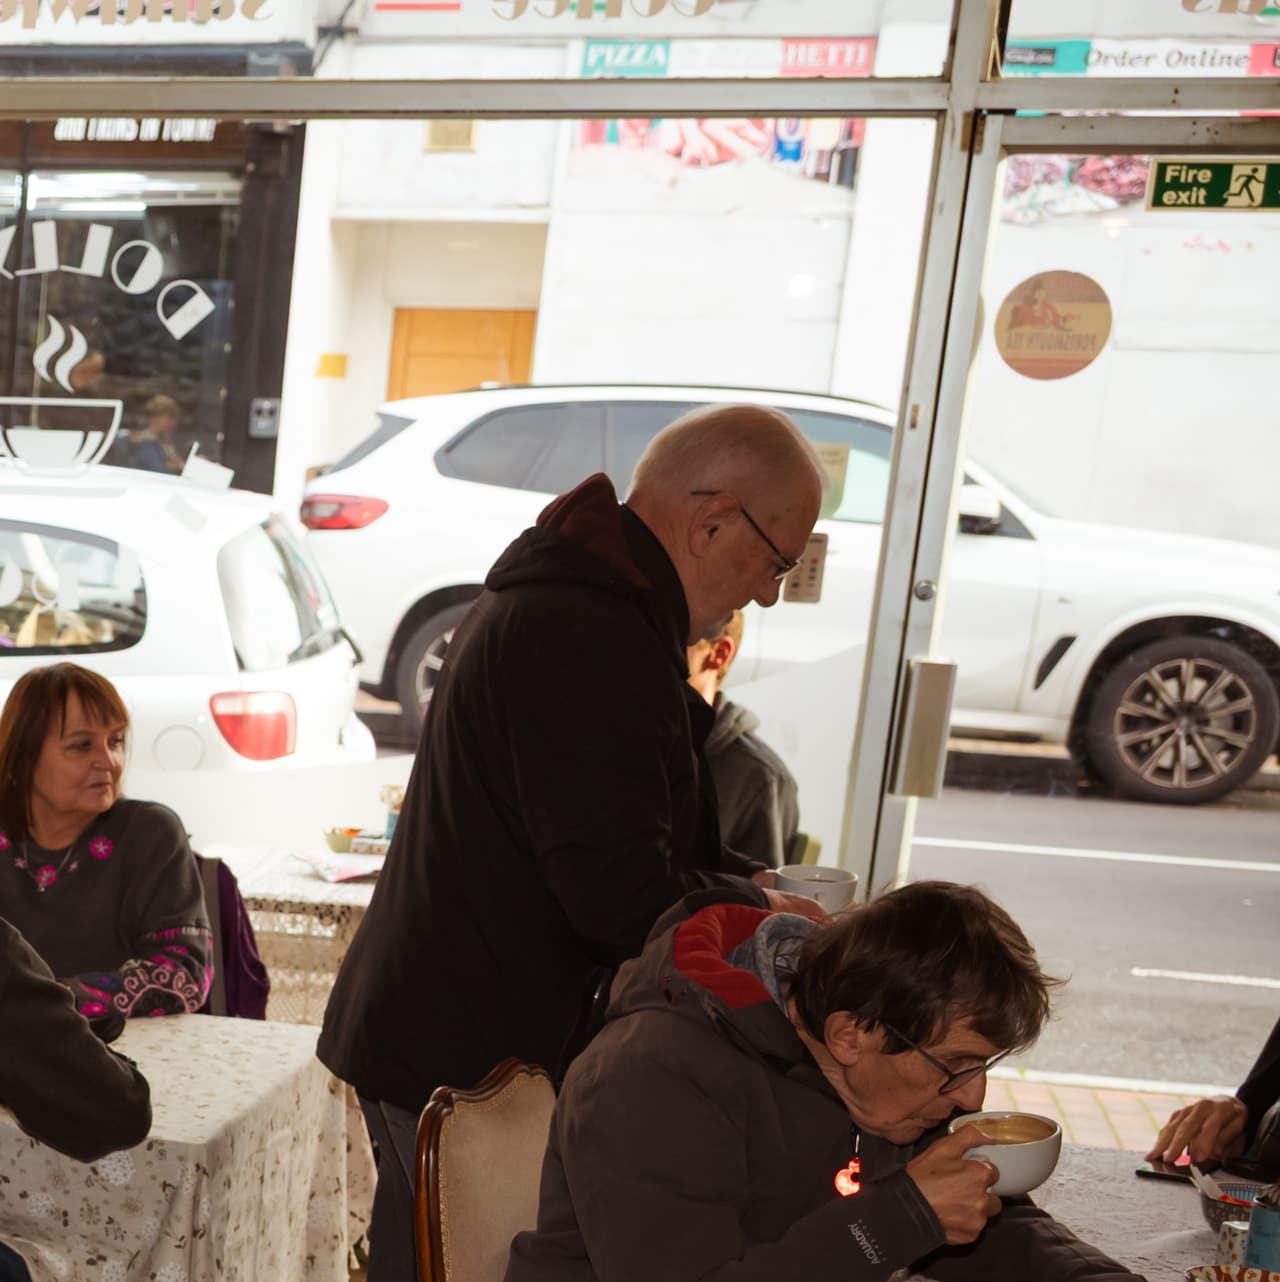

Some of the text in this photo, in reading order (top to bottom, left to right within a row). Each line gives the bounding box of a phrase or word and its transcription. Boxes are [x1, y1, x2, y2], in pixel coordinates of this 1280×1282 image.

[587, 43, 666, 66] PIZZA
[1083, 49, 1250, 68] Order Online
[1164, 164, 1213, 184] Fire
[1161, 186, 1207, 206] exit
[847, 1223, 881, 1265] AQUADRY
